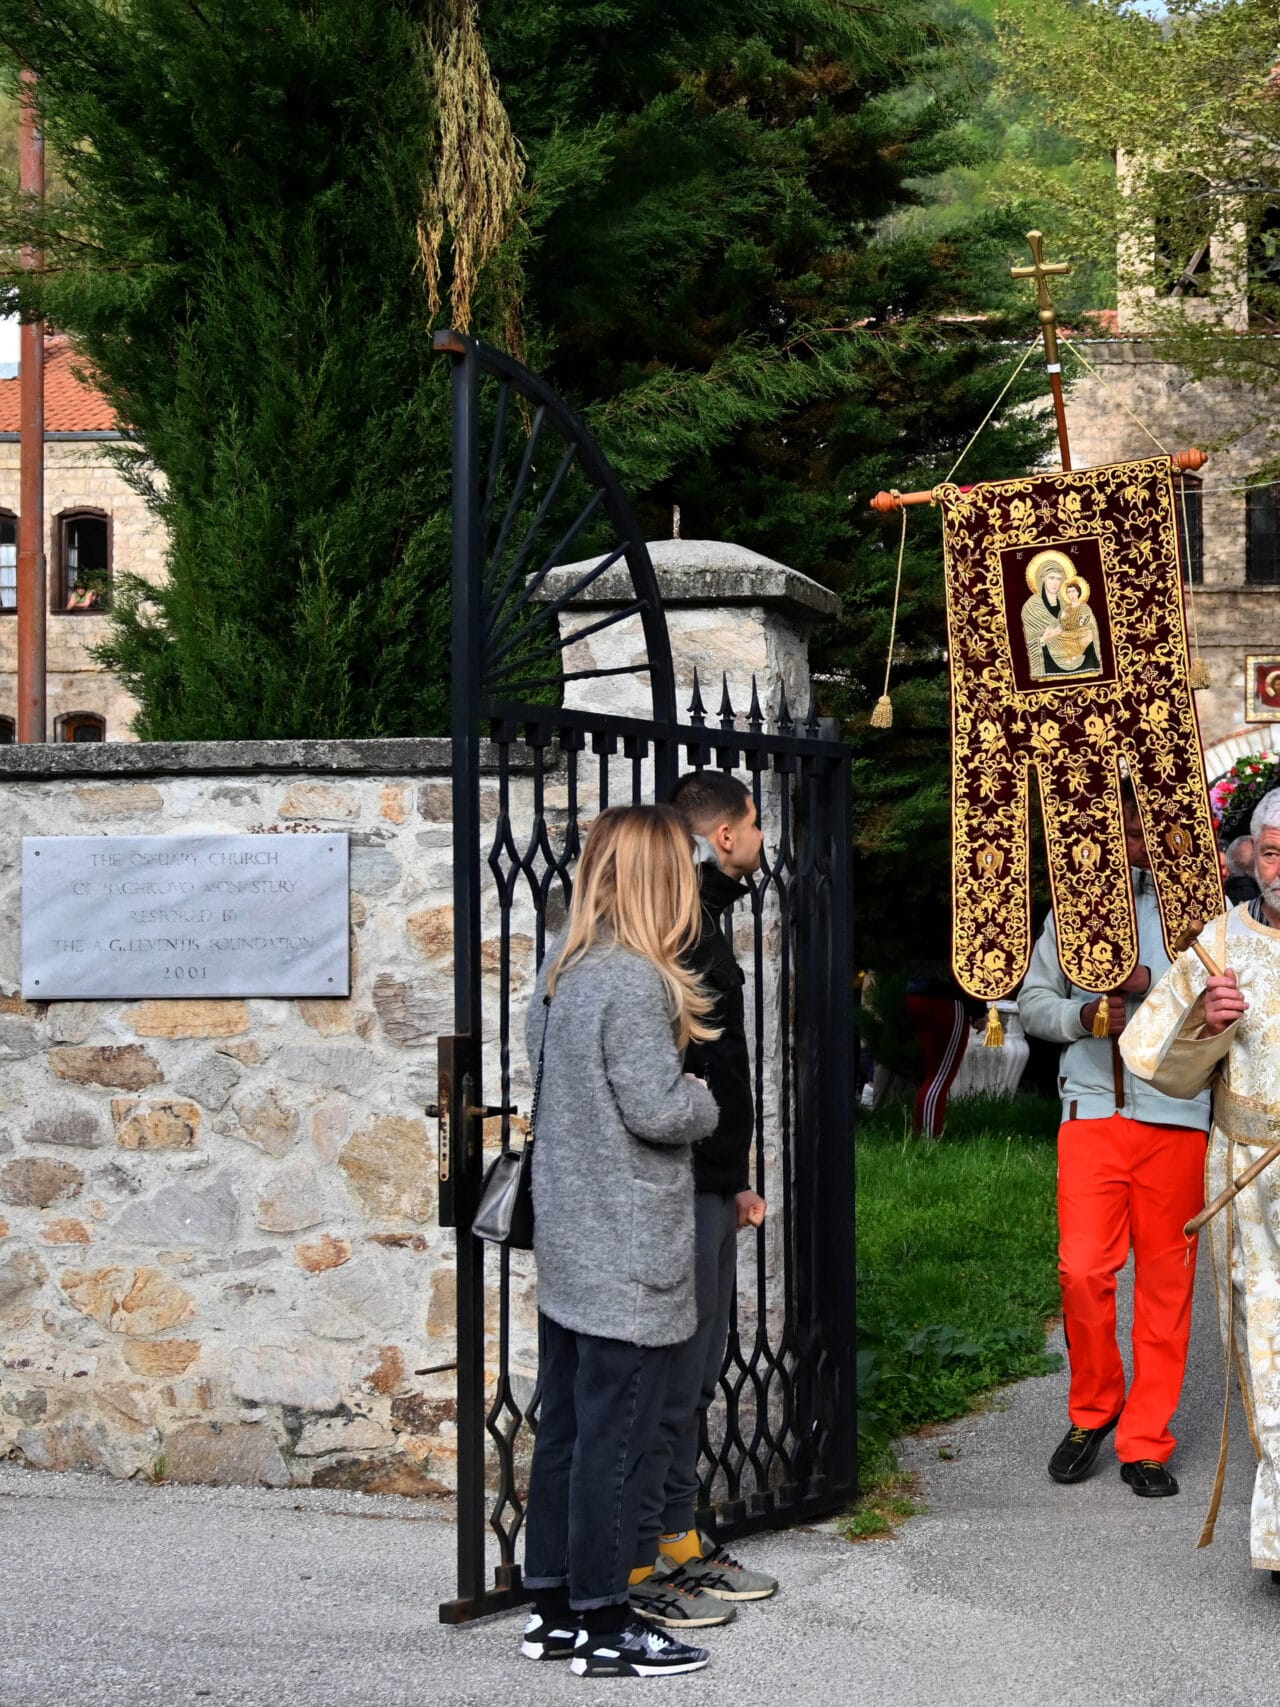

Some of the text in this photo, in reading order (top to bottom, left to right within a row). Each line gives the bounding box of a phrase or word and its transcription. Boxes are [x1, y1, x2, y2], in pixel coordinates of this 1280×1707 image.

[91, 853, 121, 867] THE
[208, 851, 279, 866] CHURCH
[72, 881, 91, 896] OF
[205, 880, 297, 895] MONASTERY
[53, 939, 84, 953] THE
[209, 936, 314, 951] FOUNDATION
[163, 966, 208, 979] 2001
